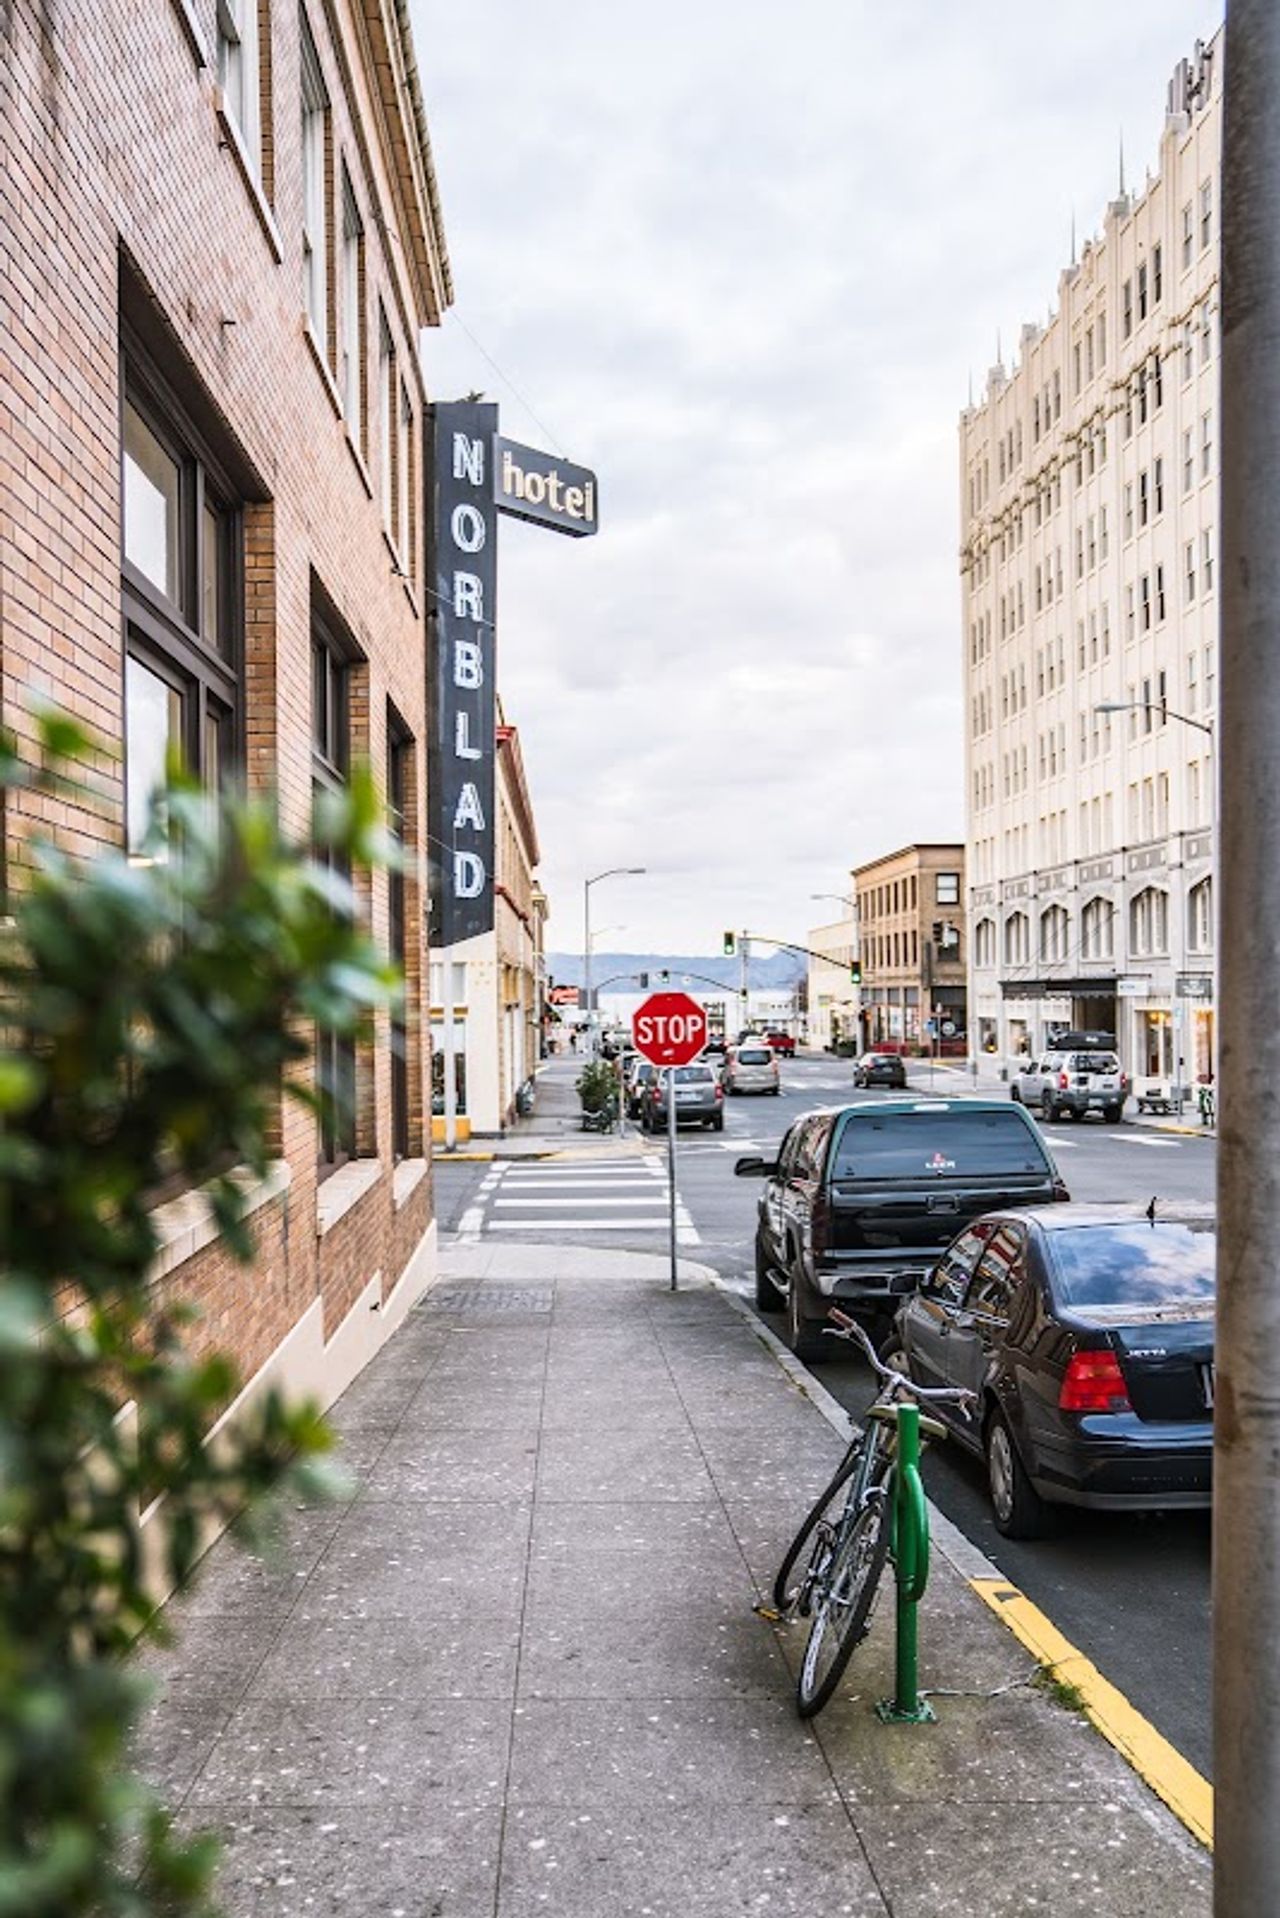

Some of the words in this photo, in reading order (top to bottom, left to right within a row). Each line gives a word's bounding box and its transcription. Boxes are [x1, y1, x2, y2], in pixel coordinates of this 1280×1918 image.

[503, 451, 593, 522] hotel
[452, 432, 486, 899] NORBLAD
[637, 1014, 703, 1044] STOP
